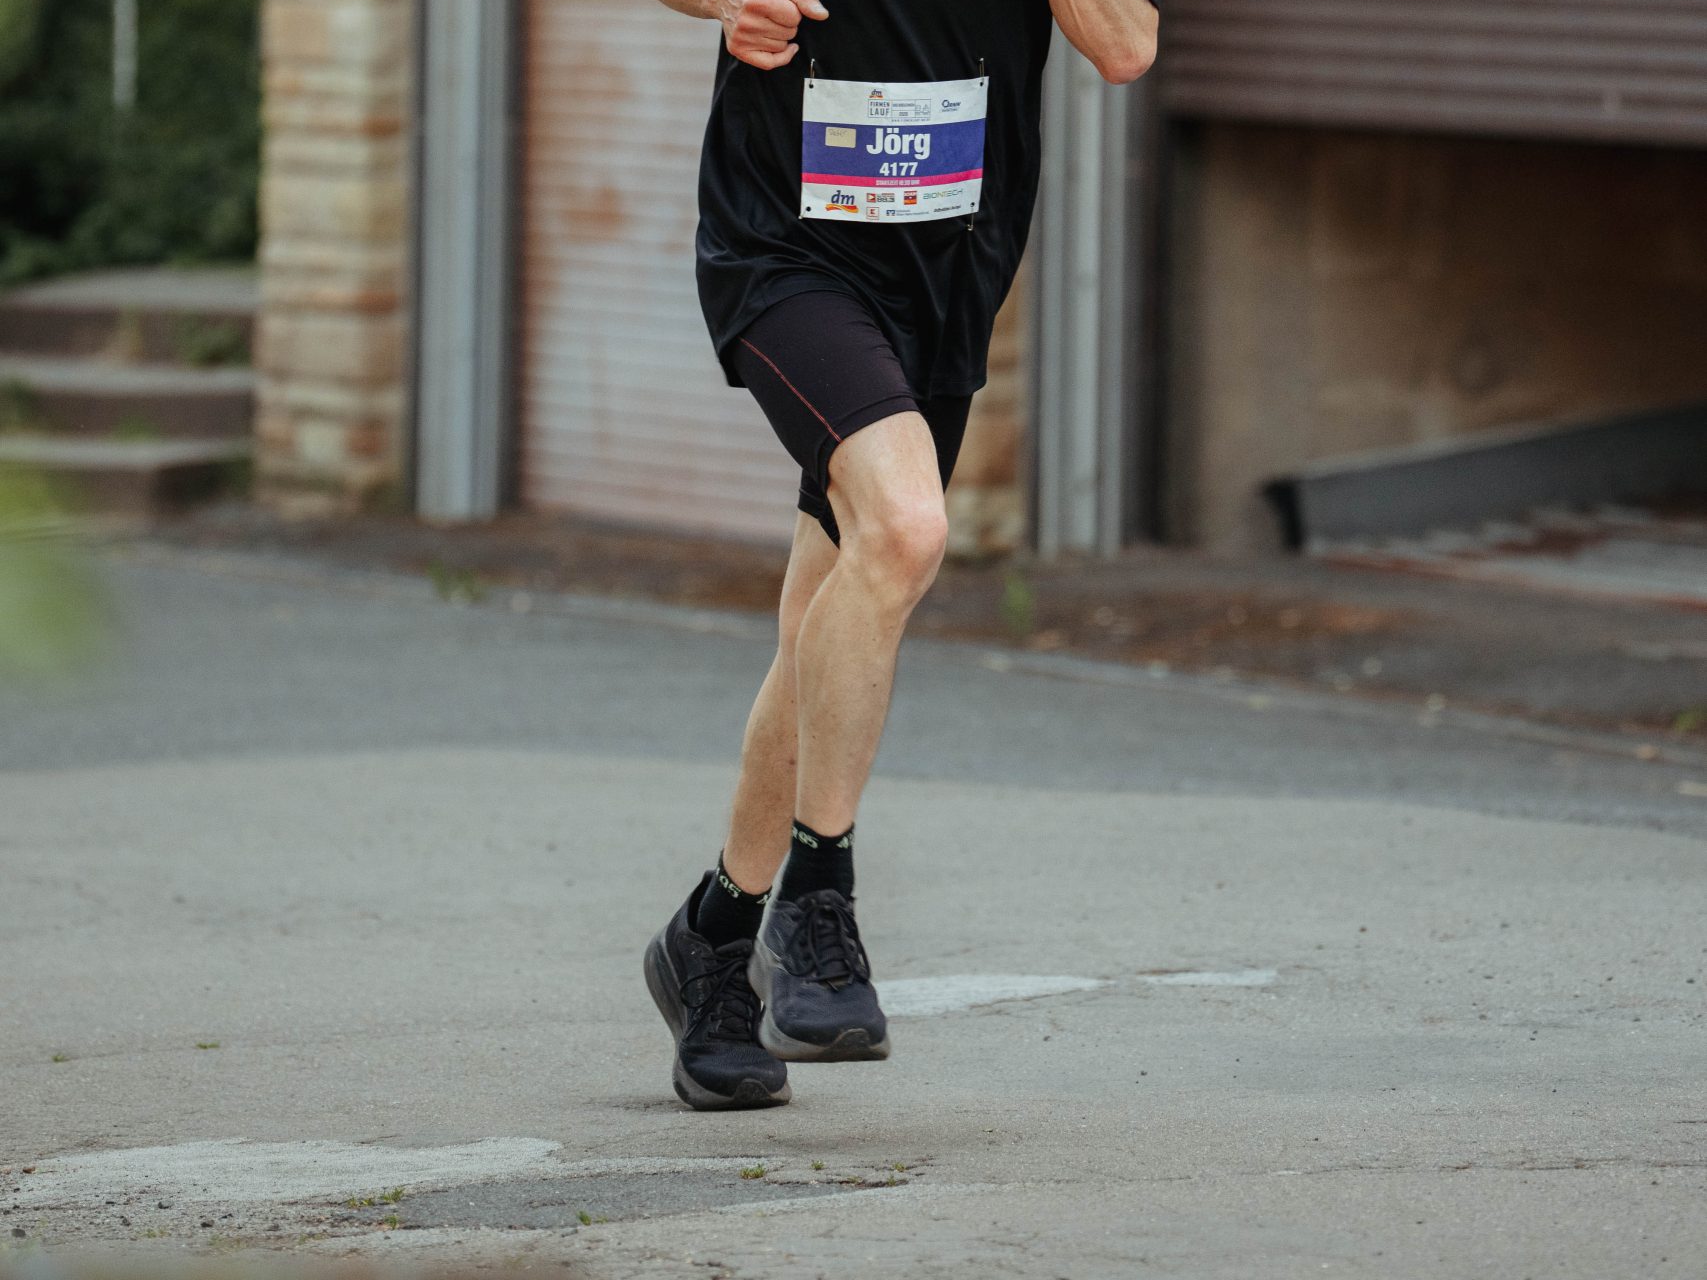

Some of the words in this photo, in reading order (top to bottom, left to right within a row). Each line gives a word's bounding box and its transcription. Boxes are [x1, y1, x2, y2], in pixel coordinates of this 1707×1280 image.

[870, 108, 890, 116] LAUF
[866, 127, 931, 160] Jörg
[879, 161, 919, 177] 4177
[831, 190, 855, 205] dm
